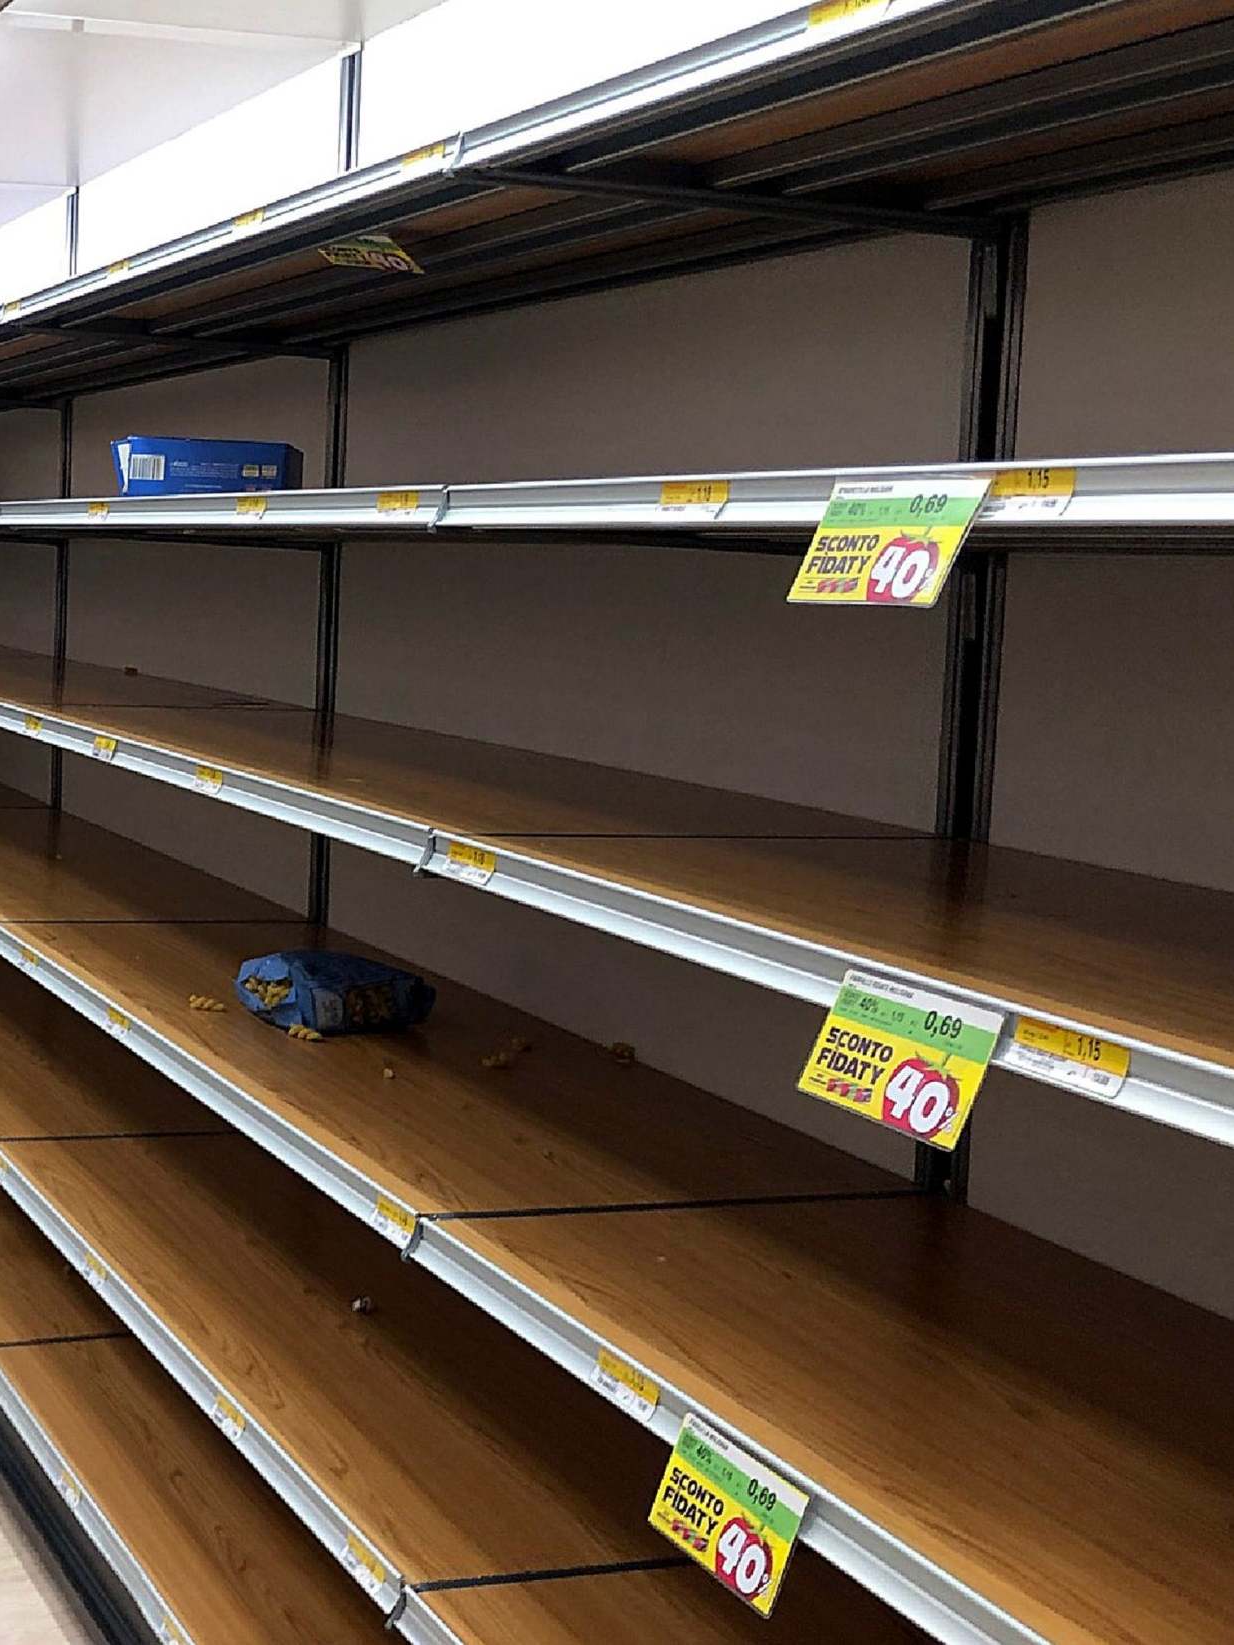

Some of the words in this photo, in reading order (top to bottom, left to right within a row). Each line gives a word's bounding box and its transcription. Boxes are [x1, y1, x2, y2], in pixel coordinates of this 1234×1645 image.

[909, 494, 948, 518] 0,69
[816, 535, 880, 552] SCONTO
[924, 1010, 963, 1039] 0,69
[826, 1026, 894, 1063] SCONTO
[1077, 1035, 1101, 1061] 1,15
[816, 1046, 885, 1085] FIDATY
[669, 1466, 724, 1516] SCONTO
[747, 1478, 777, 1511] 0,69
[662, 1485, 719, 1536] FIDATY
